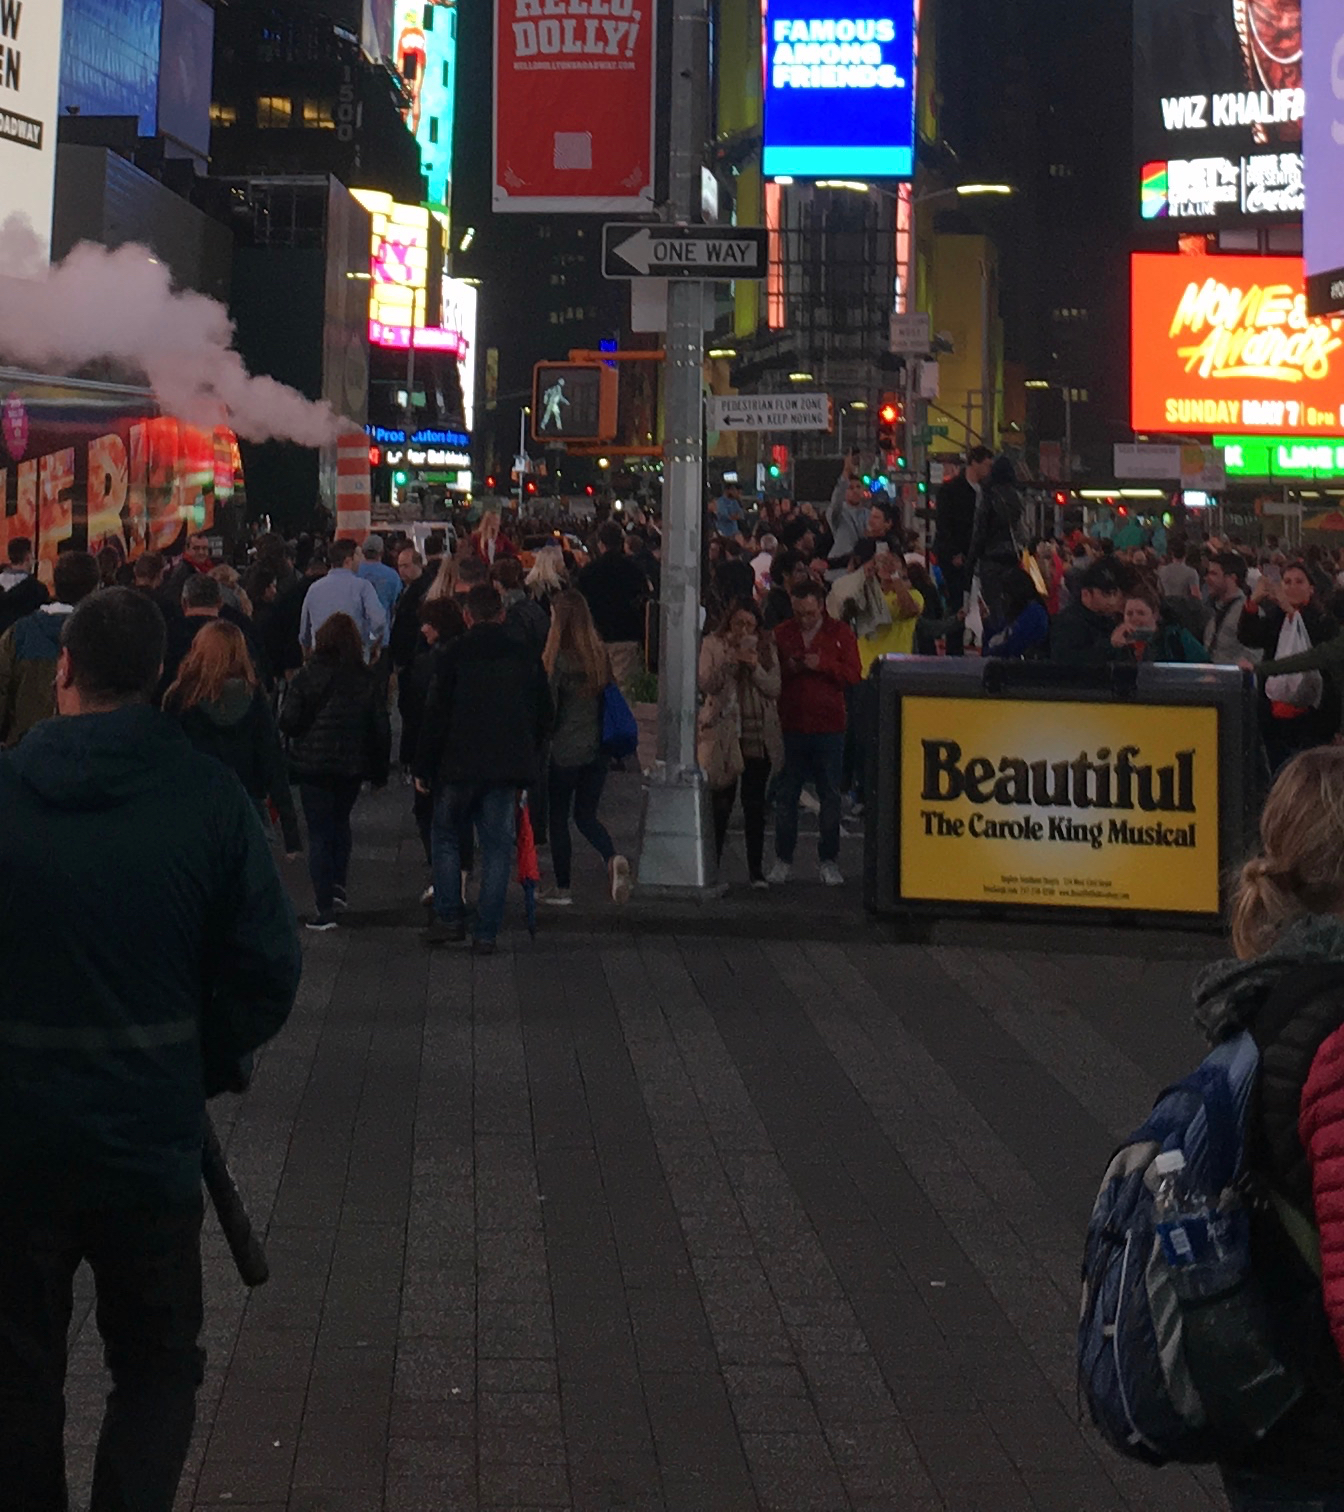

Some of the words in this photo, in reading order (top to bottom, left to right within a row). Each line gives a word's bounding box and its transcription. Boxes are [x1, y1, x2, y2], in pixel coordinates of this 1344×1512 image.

[511, 18, 641, 58] DOLLY!
[773, 18, 895, 43] FAMOUS
[773, 42, 881, 66] AMONG
[772, 63, 906, 90] FRIENDS.
[1160, 94, 1208, 130] WIZ
[1212, 87, 1305, 127] KHALIFA
[653, 239, 698, 264] ONE
[705, 239, 752, 266] WAY
[1168, 277, 1294, 338] MOVIE
[721, 399, 773, 412] PEDESTRIAN
[775, 398, 798, 410] FLOW
[800, 397, 823, 409] ZONE
[1165, 398, 1239, 424] SUNDAY
[767, 414, 787, 426] KEEP
[790, 413, 824, 425] MOVING
[920, 736, 1197, 813] Beautiful
[920, 808, 965, 837] The
[968, 813, 1044, 841] Carole
[1047, 814, 1104, 850] King
[1107, 818, 1197, 848] Musical
